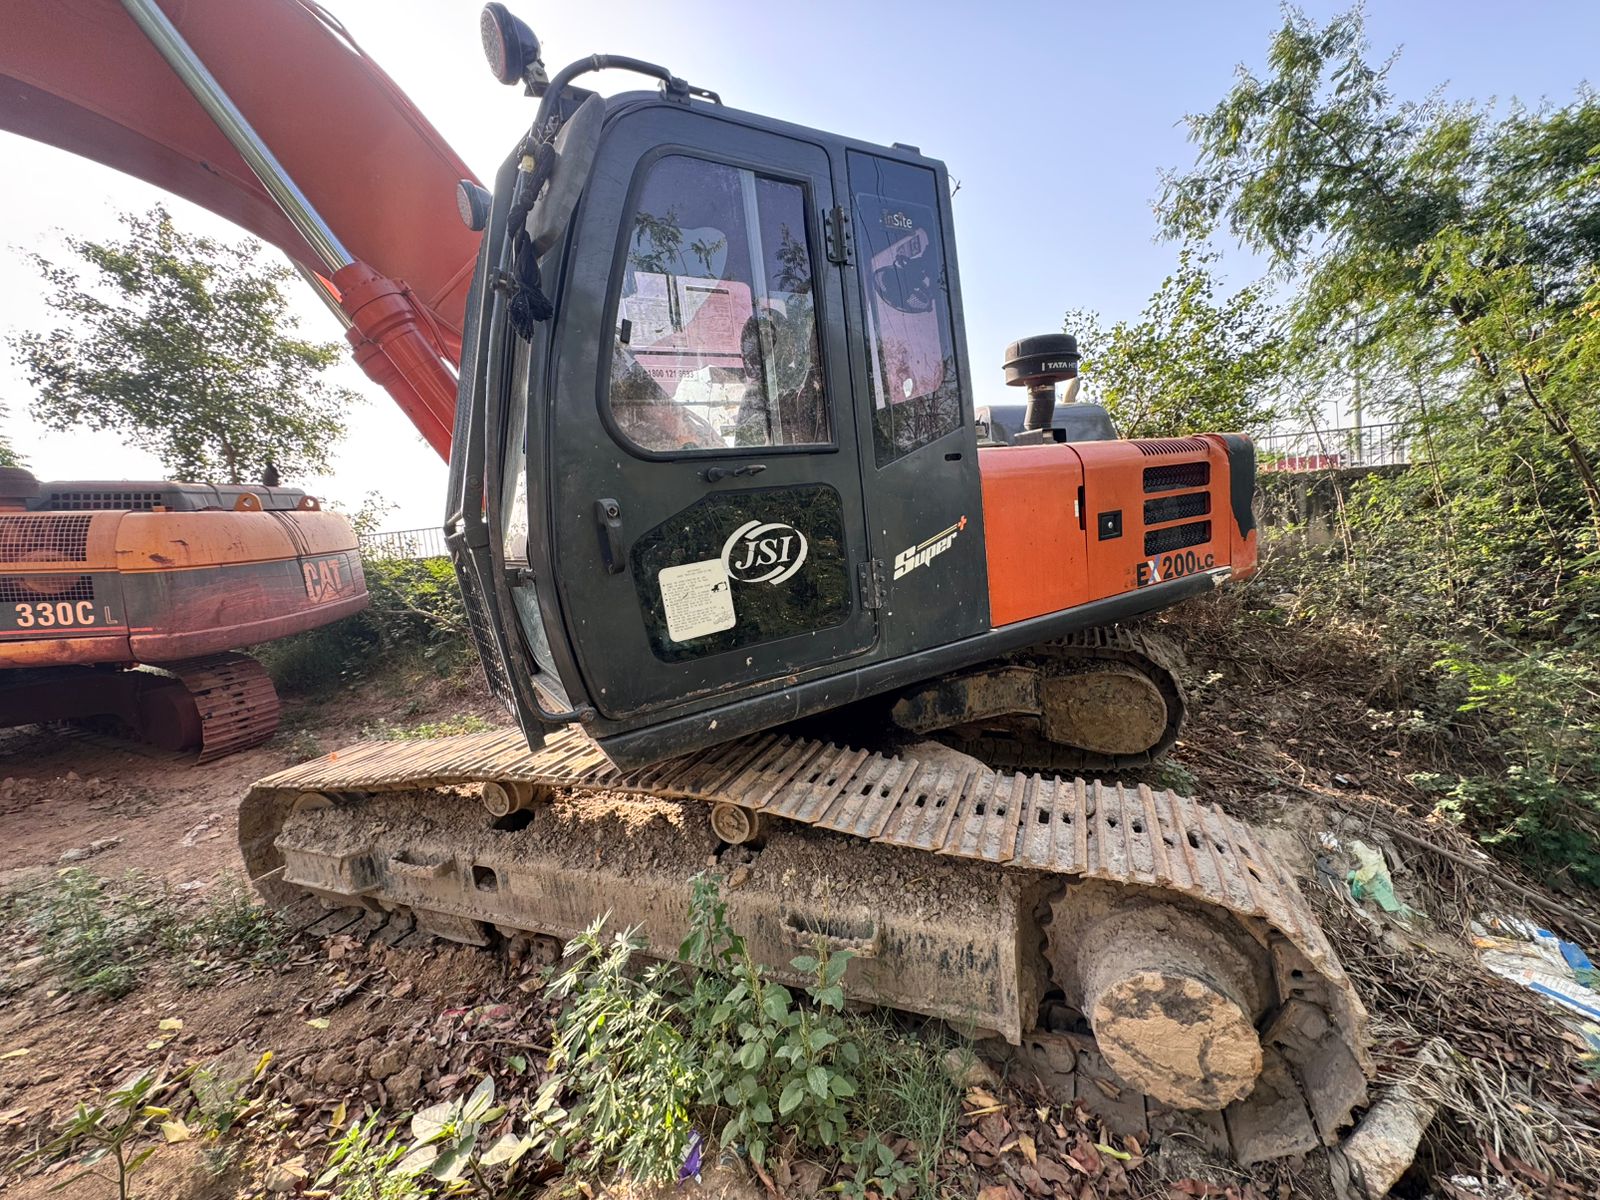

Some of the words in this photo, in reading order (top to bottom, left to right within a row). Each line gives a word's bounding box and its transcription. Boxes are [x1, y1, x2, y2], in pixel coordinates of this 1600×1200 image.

[1048, 361, 1068, 369] TATA
[735, 535, 793, 570] JSI
[303, 559, 342, 604] CAT
[15, 601, 95, 627] 330C
[103, 605, 119, 625] L
